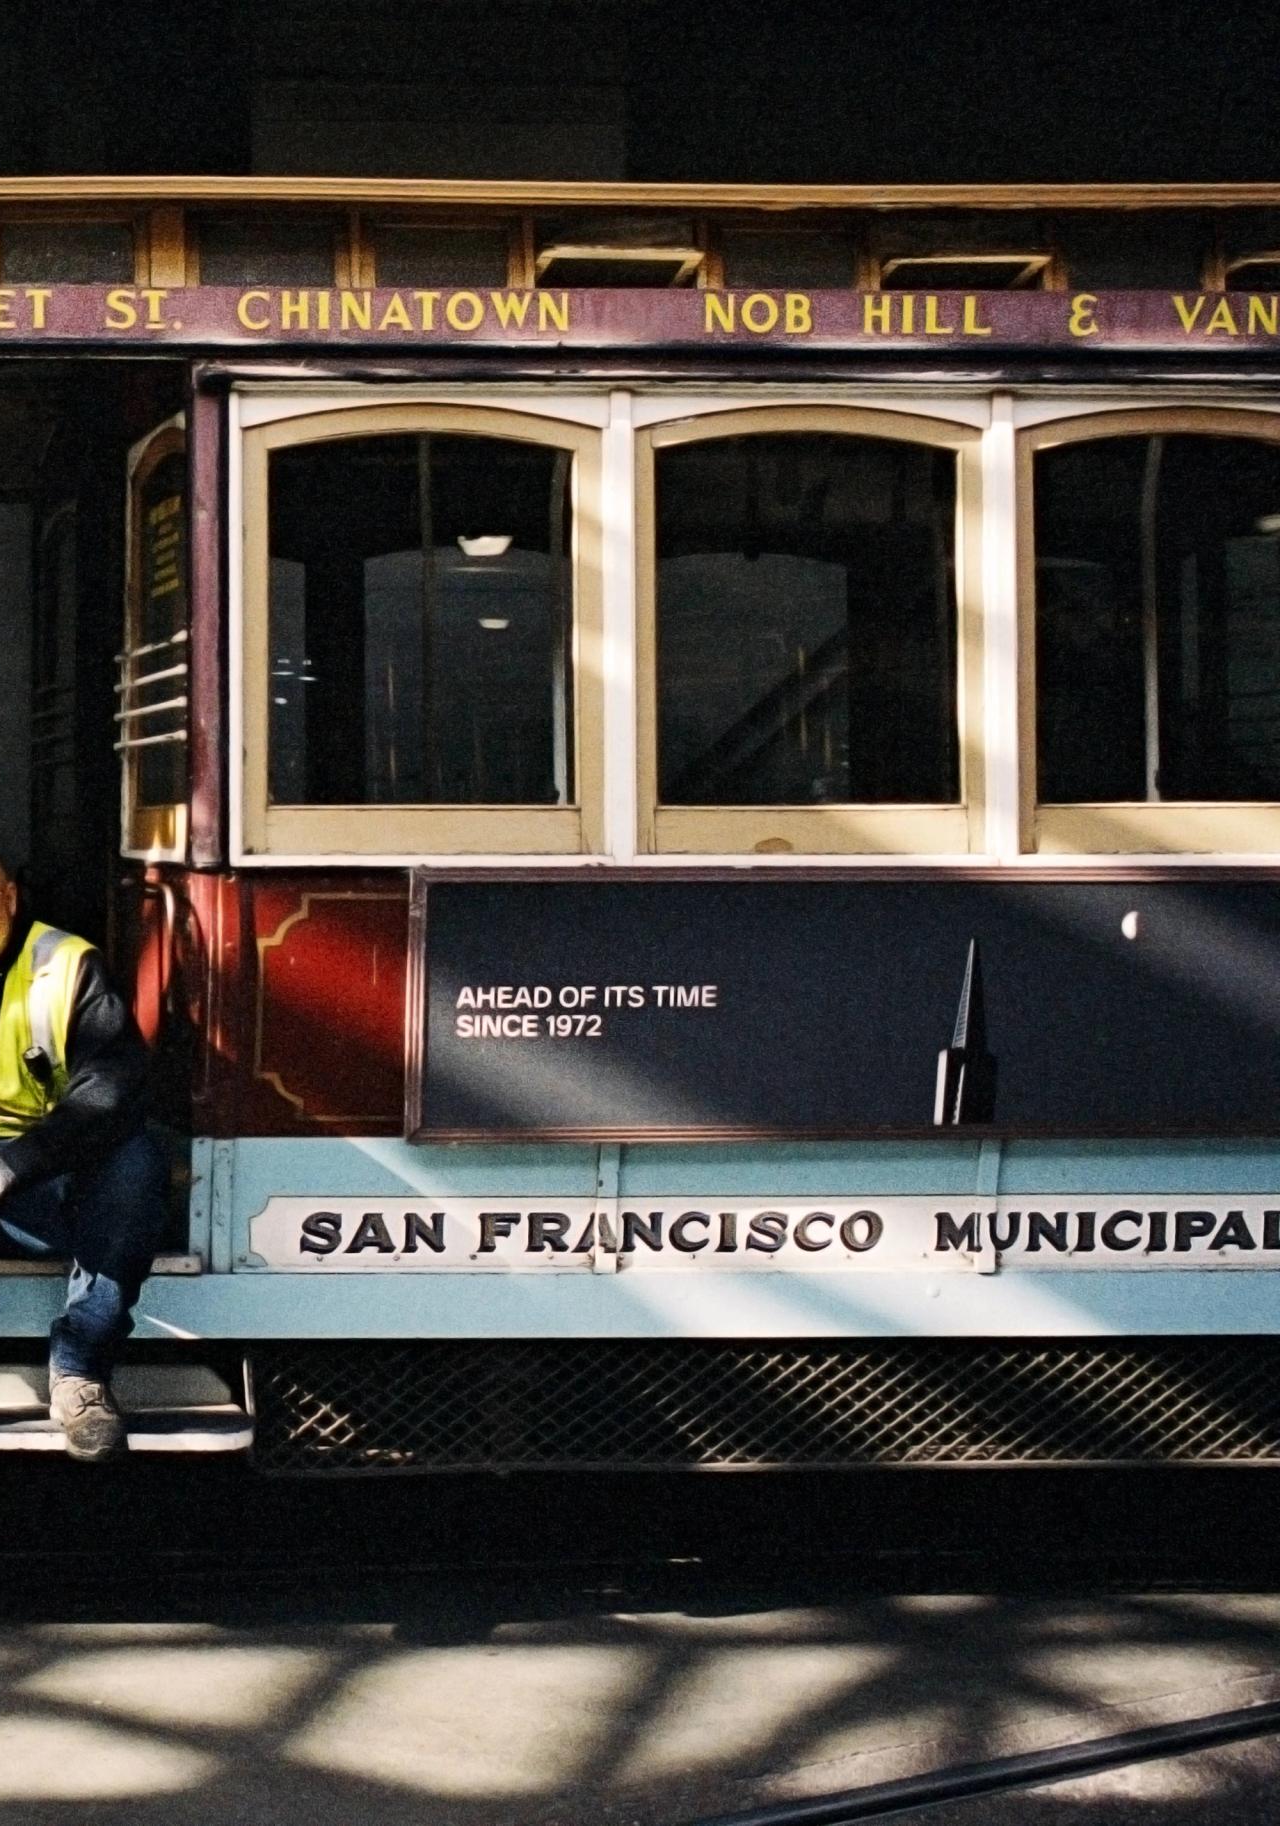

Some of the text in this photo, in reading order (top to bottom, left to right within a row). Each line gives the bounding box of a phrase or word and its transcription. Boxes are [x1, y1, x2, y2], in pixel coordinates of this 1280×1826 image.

[236, 290, 569, 332] CHINATOWN
[704, 293, 813, 335] NOB
[863, 294, 993, 336] HILL
[1068, 293, 1099, 337] &
[1172, 294, 1279, 336] VAN
[456, 984, 718, 1009] AHEAD OF ITS TIME
[456, 1014, 602, 1037] SINCE 1972
[299, 1210, 447, 1255] SAN
[476, 1209, 884, 1254] FRANCISCO
